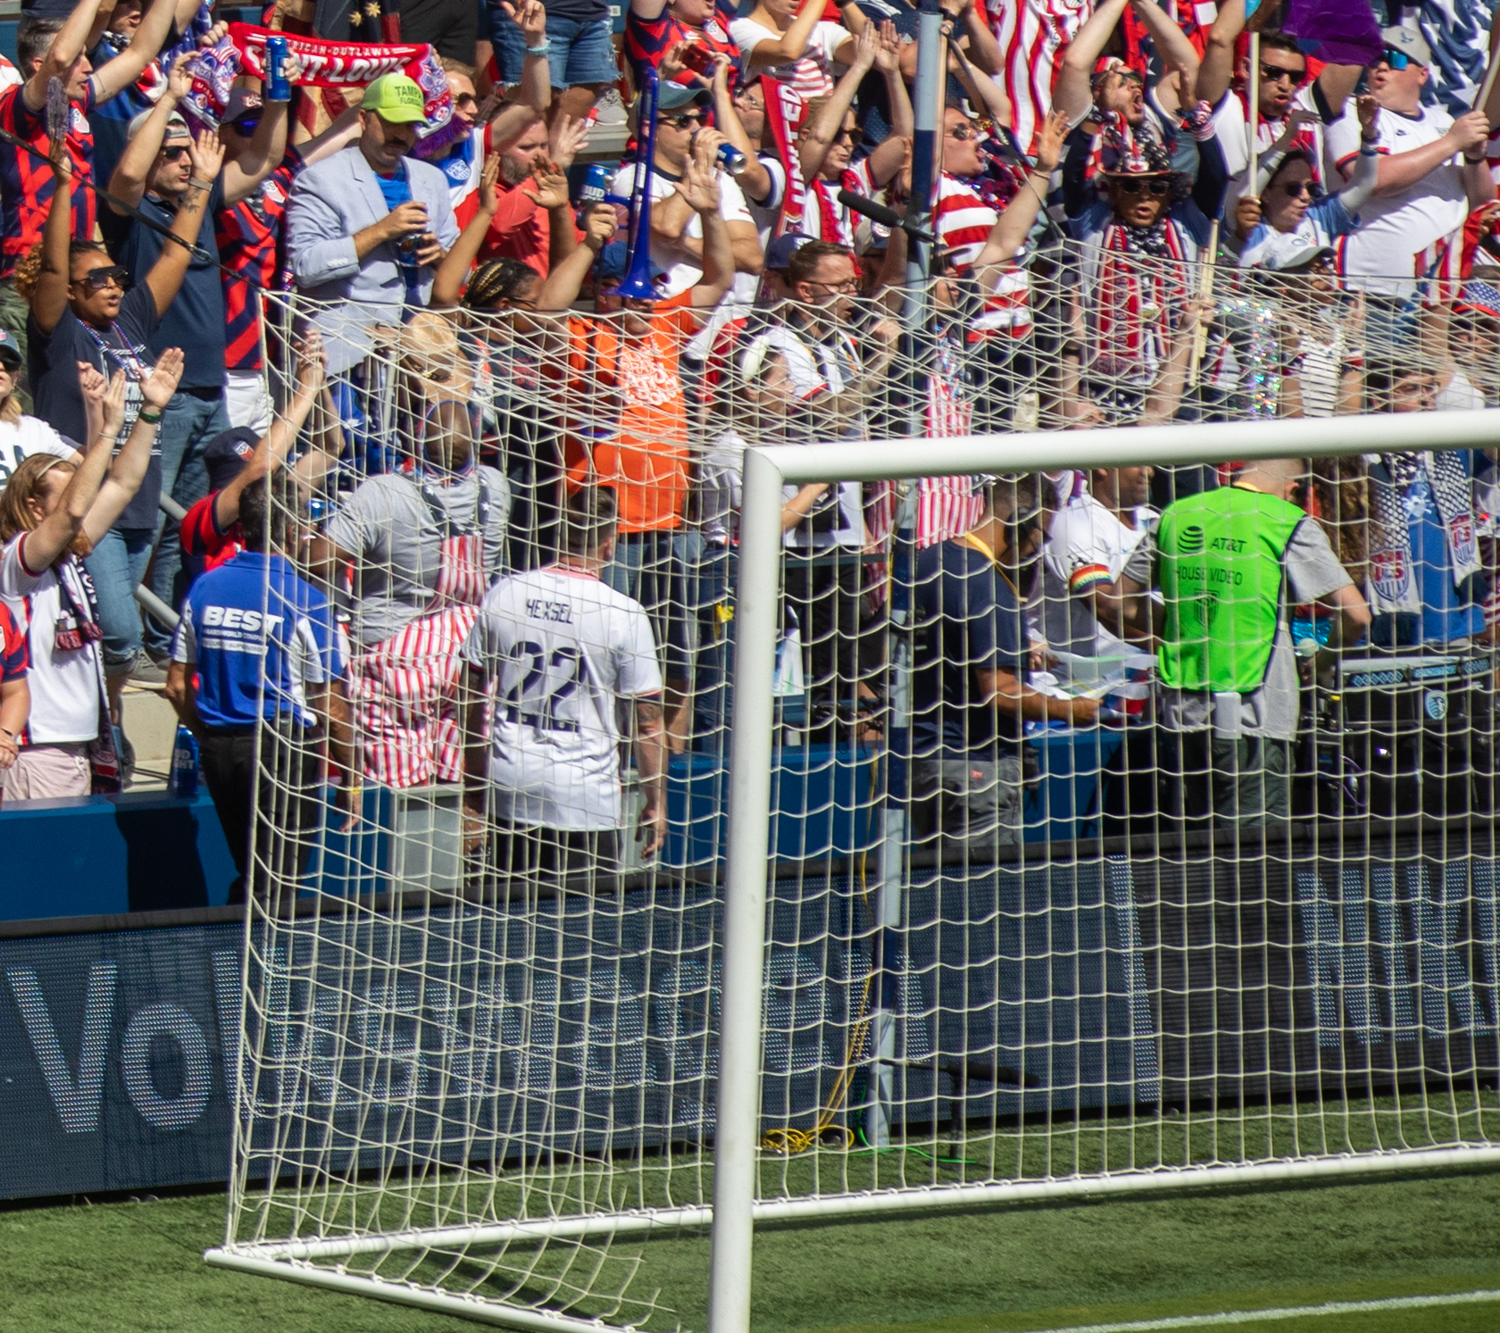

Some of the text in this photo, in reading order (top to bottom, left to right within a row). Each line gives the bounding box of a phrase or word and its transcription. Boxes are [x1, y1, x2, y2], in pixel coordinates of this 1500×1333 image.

[1210, 536, 1247, 554] AT&T
[205, 604, 285, 634] BEST
[504, 641, 586, 733] 22
